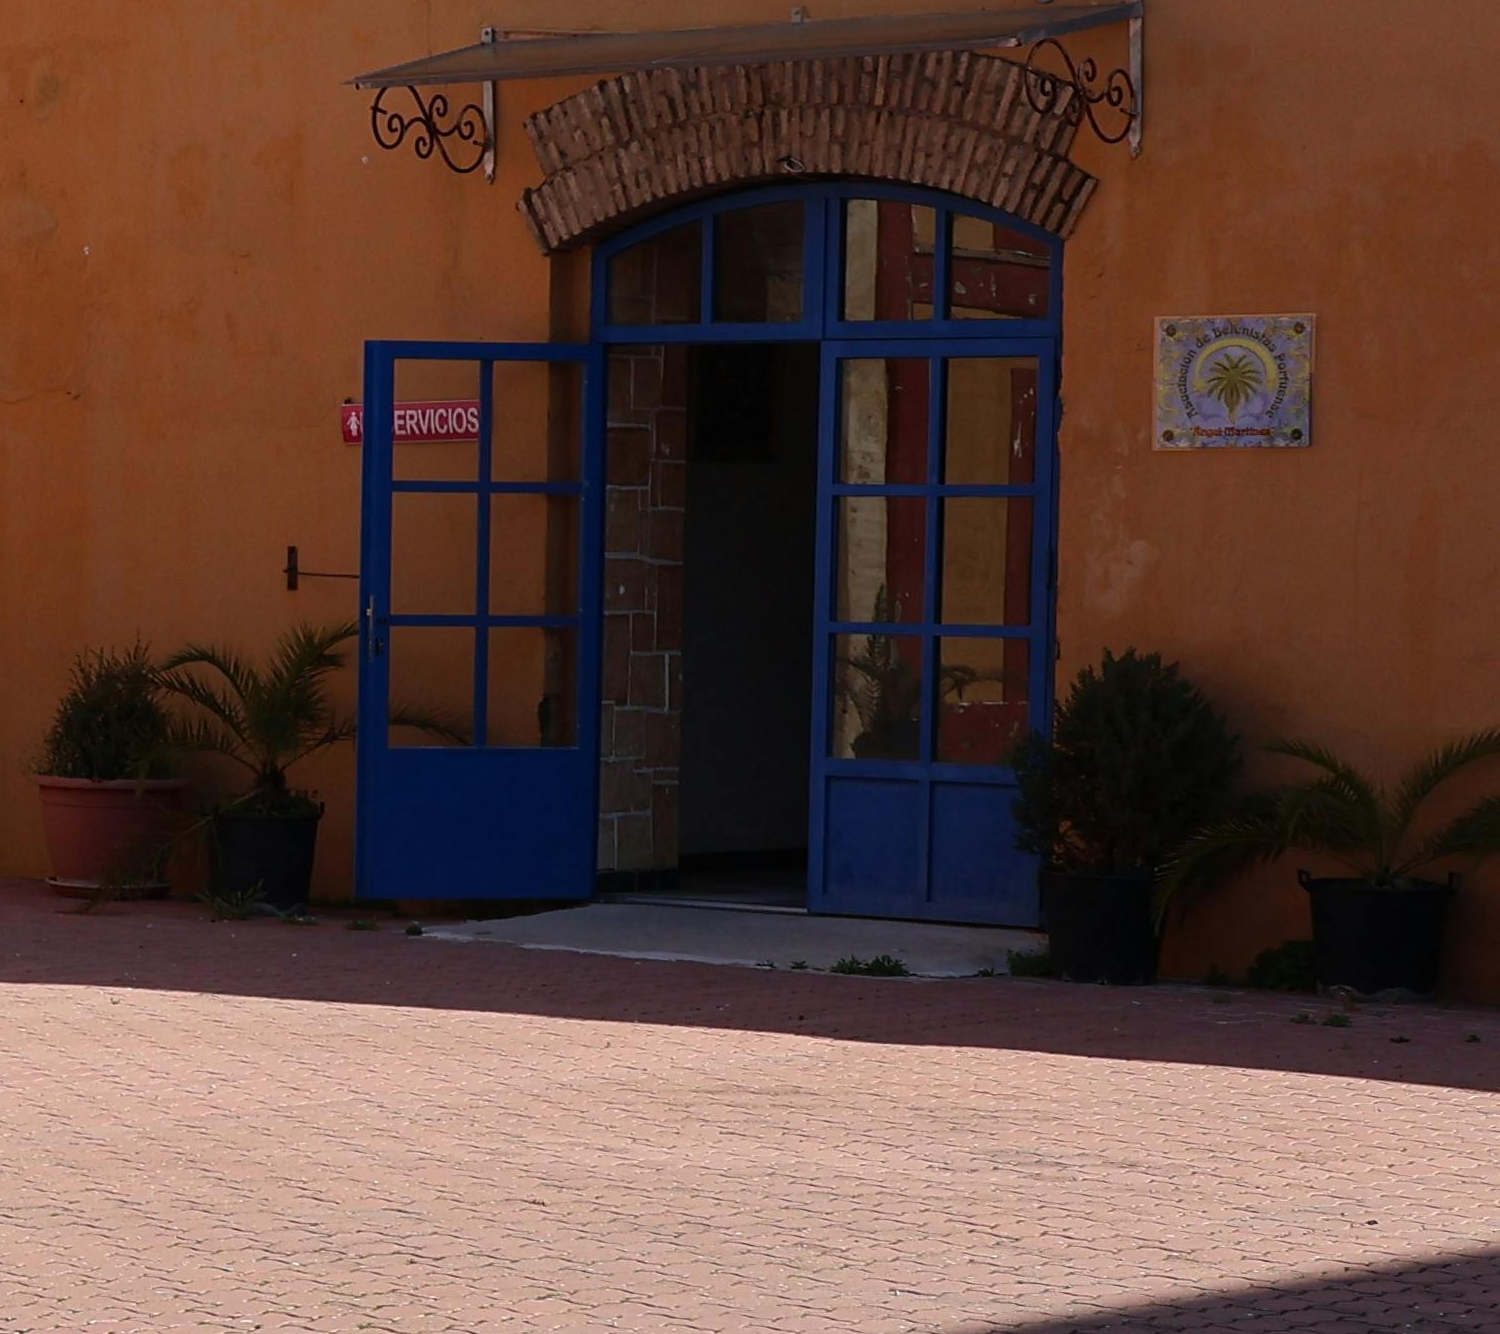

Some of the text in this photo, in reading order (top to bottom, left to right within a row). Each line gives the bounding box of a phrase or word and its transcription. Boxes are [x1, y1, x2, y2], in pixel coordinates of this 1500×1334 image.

[1195, 332, 1212, 349] de
[1211, 322, 1277, 353] Belenistas
[394, 406, 480, 436] ERVICIOS
